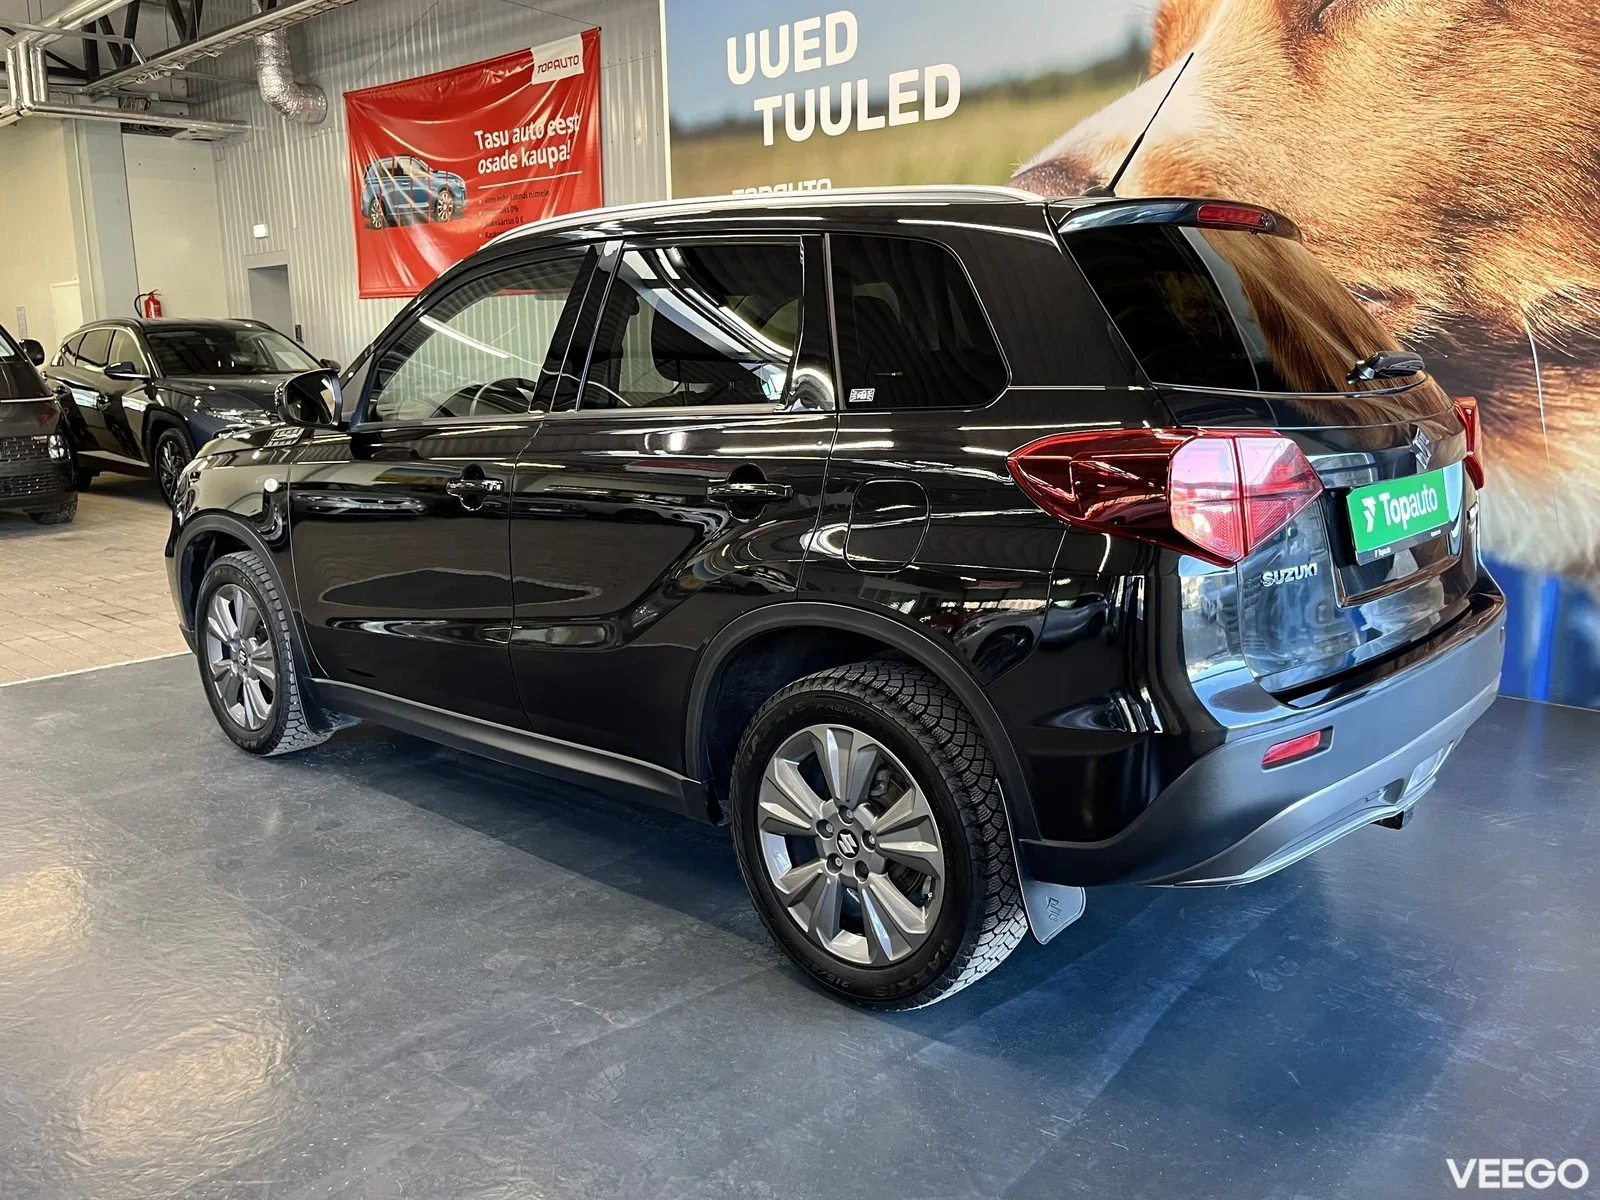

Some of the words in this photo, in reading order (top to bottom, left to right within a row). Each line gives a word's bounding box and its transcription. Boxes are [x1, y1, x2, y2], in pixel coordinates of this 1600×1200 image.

[537, 55, 580, 74] TOPAUTO
[727, 10, 858, 85] UUED
[754, 63, 961, 146] TUULED
[474, 129, 509, 150] Tasu
[512, 122, 544, 144] auto
[547, 113, 580, 137] eest
[478, 149, 518, 174] osade
[521, 139, 571, 169] kaupa!
[1379, 484, 1438, 530] Topauto
[1261, 562, 1318, 588] SUZUKI
